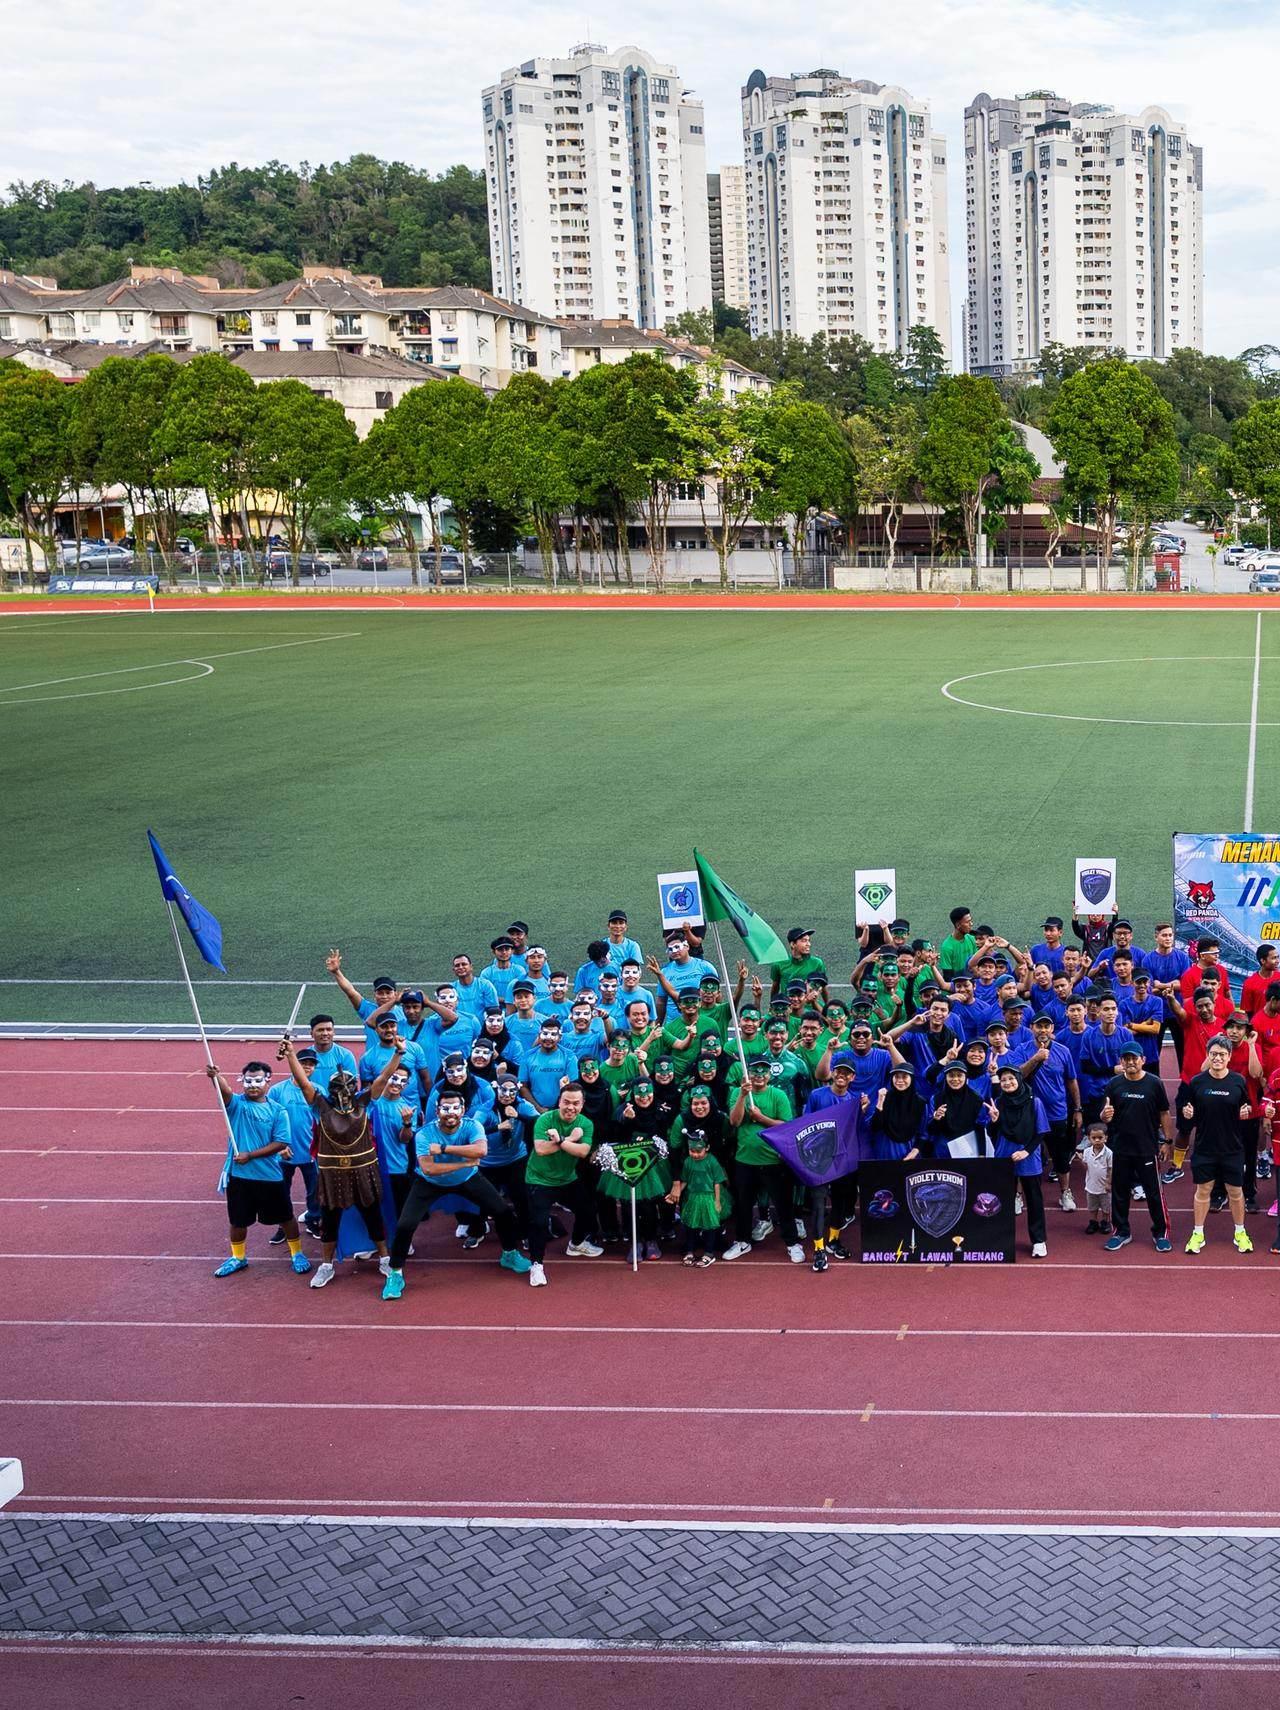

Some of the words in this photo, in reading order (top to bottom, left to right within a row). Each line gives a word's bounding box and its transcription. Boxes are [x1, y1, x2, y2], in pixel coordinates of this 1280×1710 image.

[795, 1125, 816, 1141] VIOLET
[816, 1120, 836, 1132] VENOM
[909, 1172, 935, 1186] VIOLET
[936, 1172, 964, 1186] VENOM
[862, 1251, 909, 1262] BANGKT
[920, 1252, 953, 1261] LAWAN
[963, 1252, 1004, 1261] MENANG
